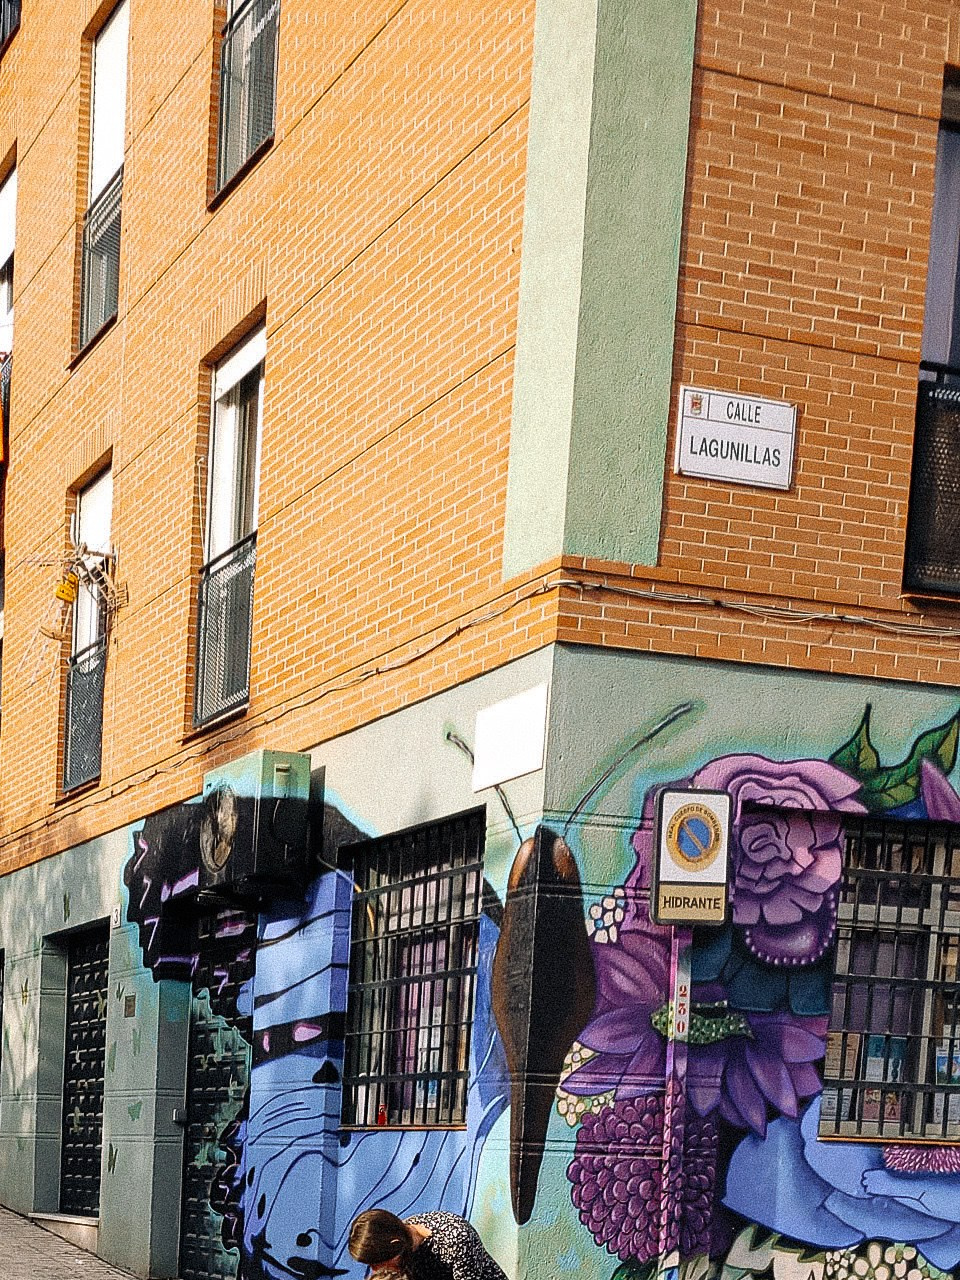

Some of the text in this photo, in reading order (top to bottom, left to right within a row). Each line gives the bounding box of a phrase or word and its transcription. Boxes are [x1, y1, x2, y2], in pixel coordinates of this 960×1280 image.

[726, 401, 761, 423] CALLE
[690, 435, 781, 467] LAGUNILLAS
[663, 895, 721, 910] HIDRANTE
